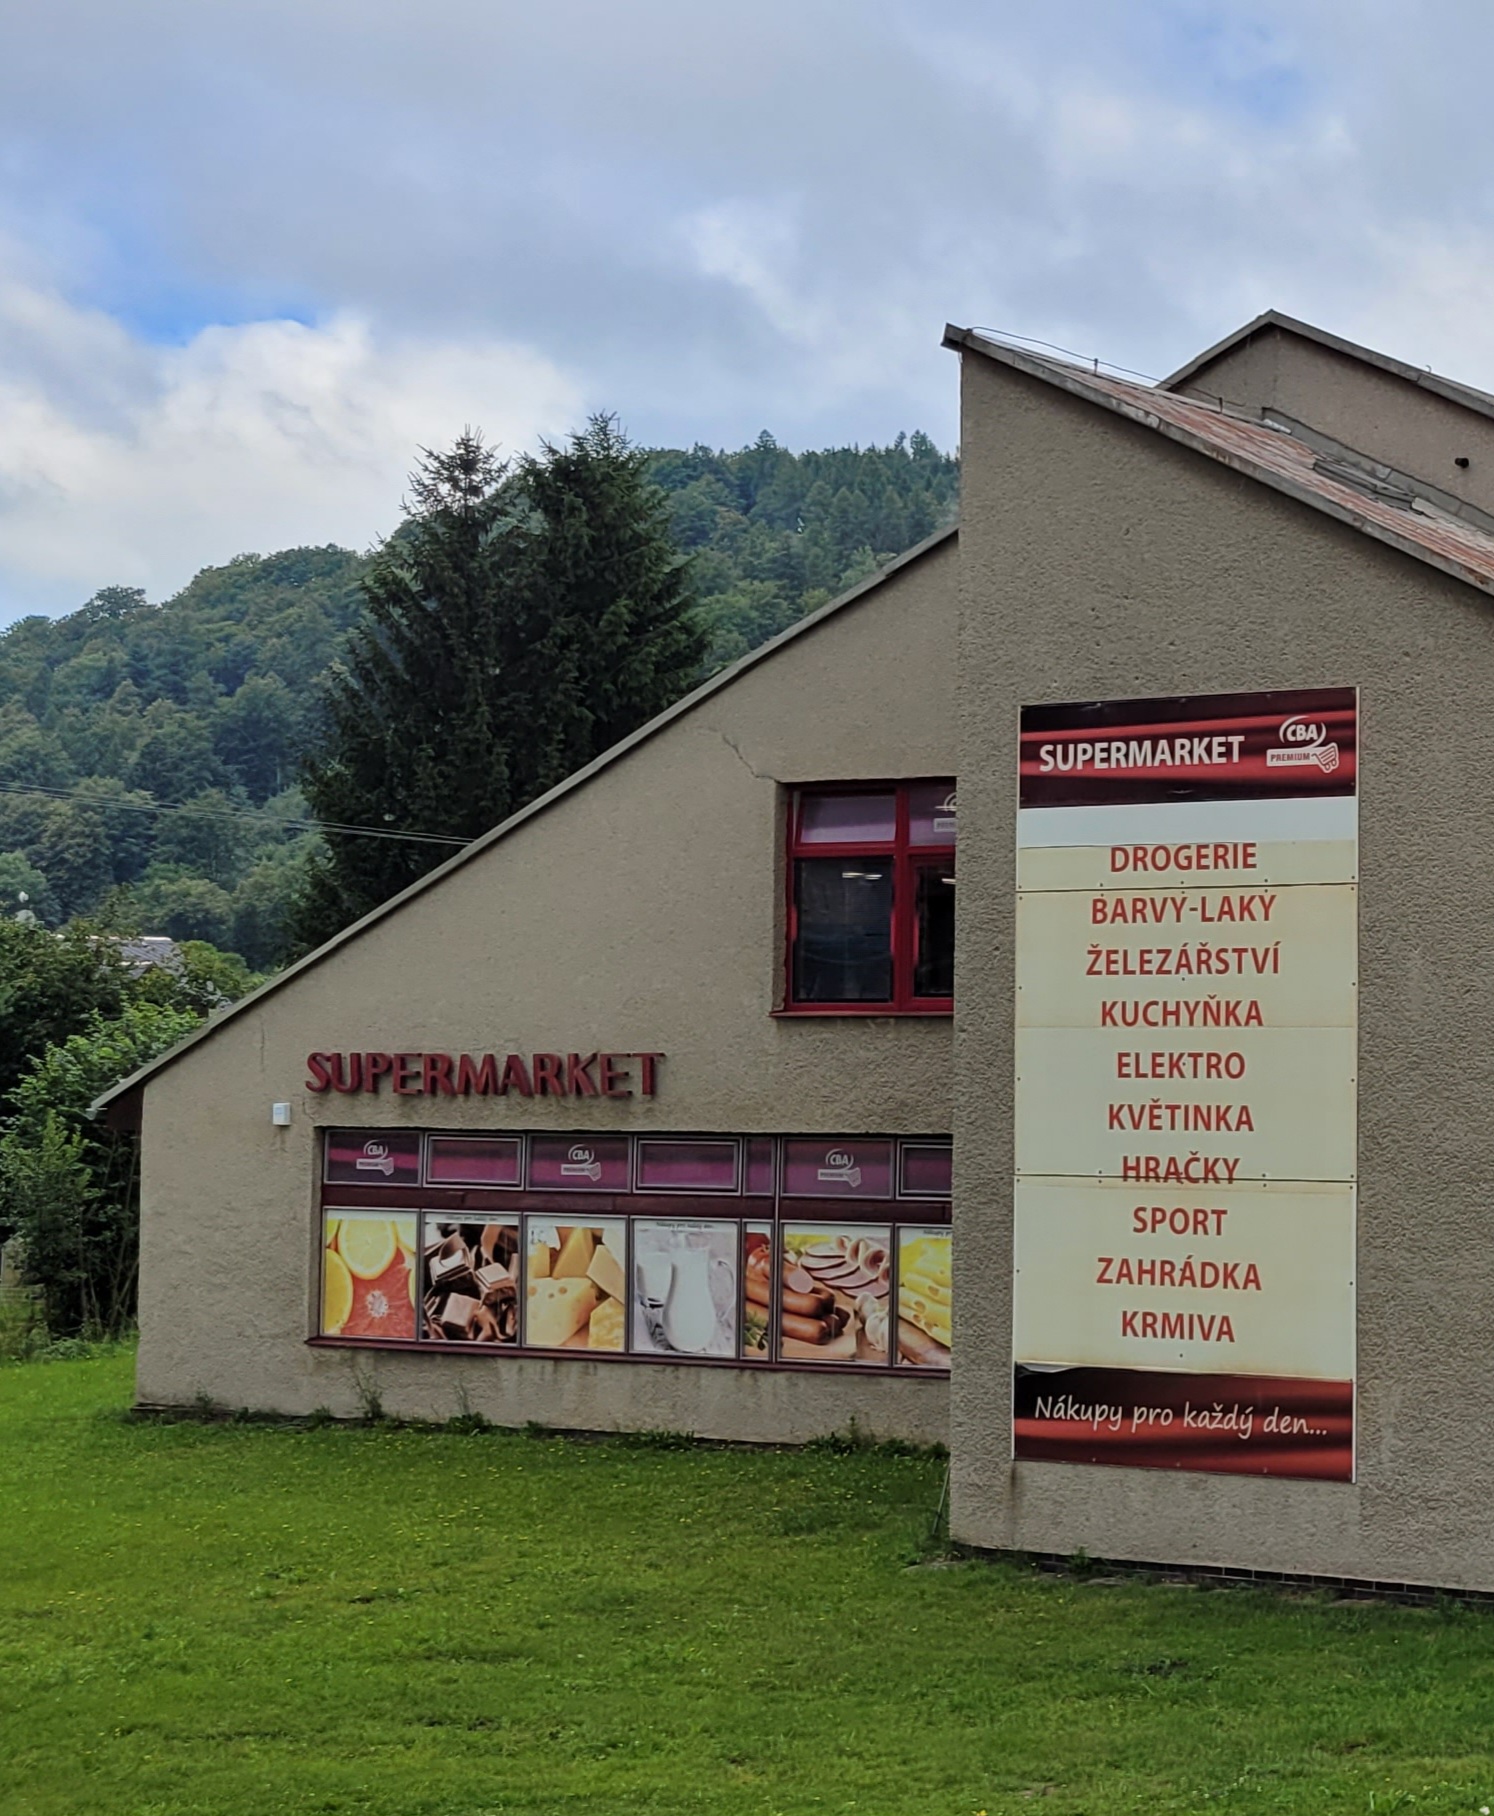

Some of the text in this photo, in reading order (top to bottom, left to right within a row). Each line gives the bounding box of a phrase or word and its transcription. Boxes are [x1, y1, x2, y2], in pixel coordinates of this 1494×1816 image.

[1285, 723, 1320, 742] CBA
[1039, 735, 1246, 772] SUPERMARKET
[1269, 751, 1311, 764] PREMIUM
[1110, 842, 1258, 872] DROGERIE
[1091, 894, 1277, 924] BARVY-LAKY
[1085, 941, 1282, 976] ŽELEZÁŘSTVÍ
[1101, 994, 1264, 1027] KUCHYŇKA
[305, 1051, 666, 1097] SUPERMARKET
[1117, 1051, 1247, 1079] ELEKTRO
[1108, 1098, 1255, 1132] KVĚTINKA
[1122, 1151, 1240, 1185] HRAČKY
[1132, 1206, 1228, 1236] SPORT
[1096, 1255, 1262, 1291] ZAHRÁDKA
[1121, 1310, 1236, 1343] KRMIVA
[1035, 1395, 1328, 1439] Nákupy pro každý den...
